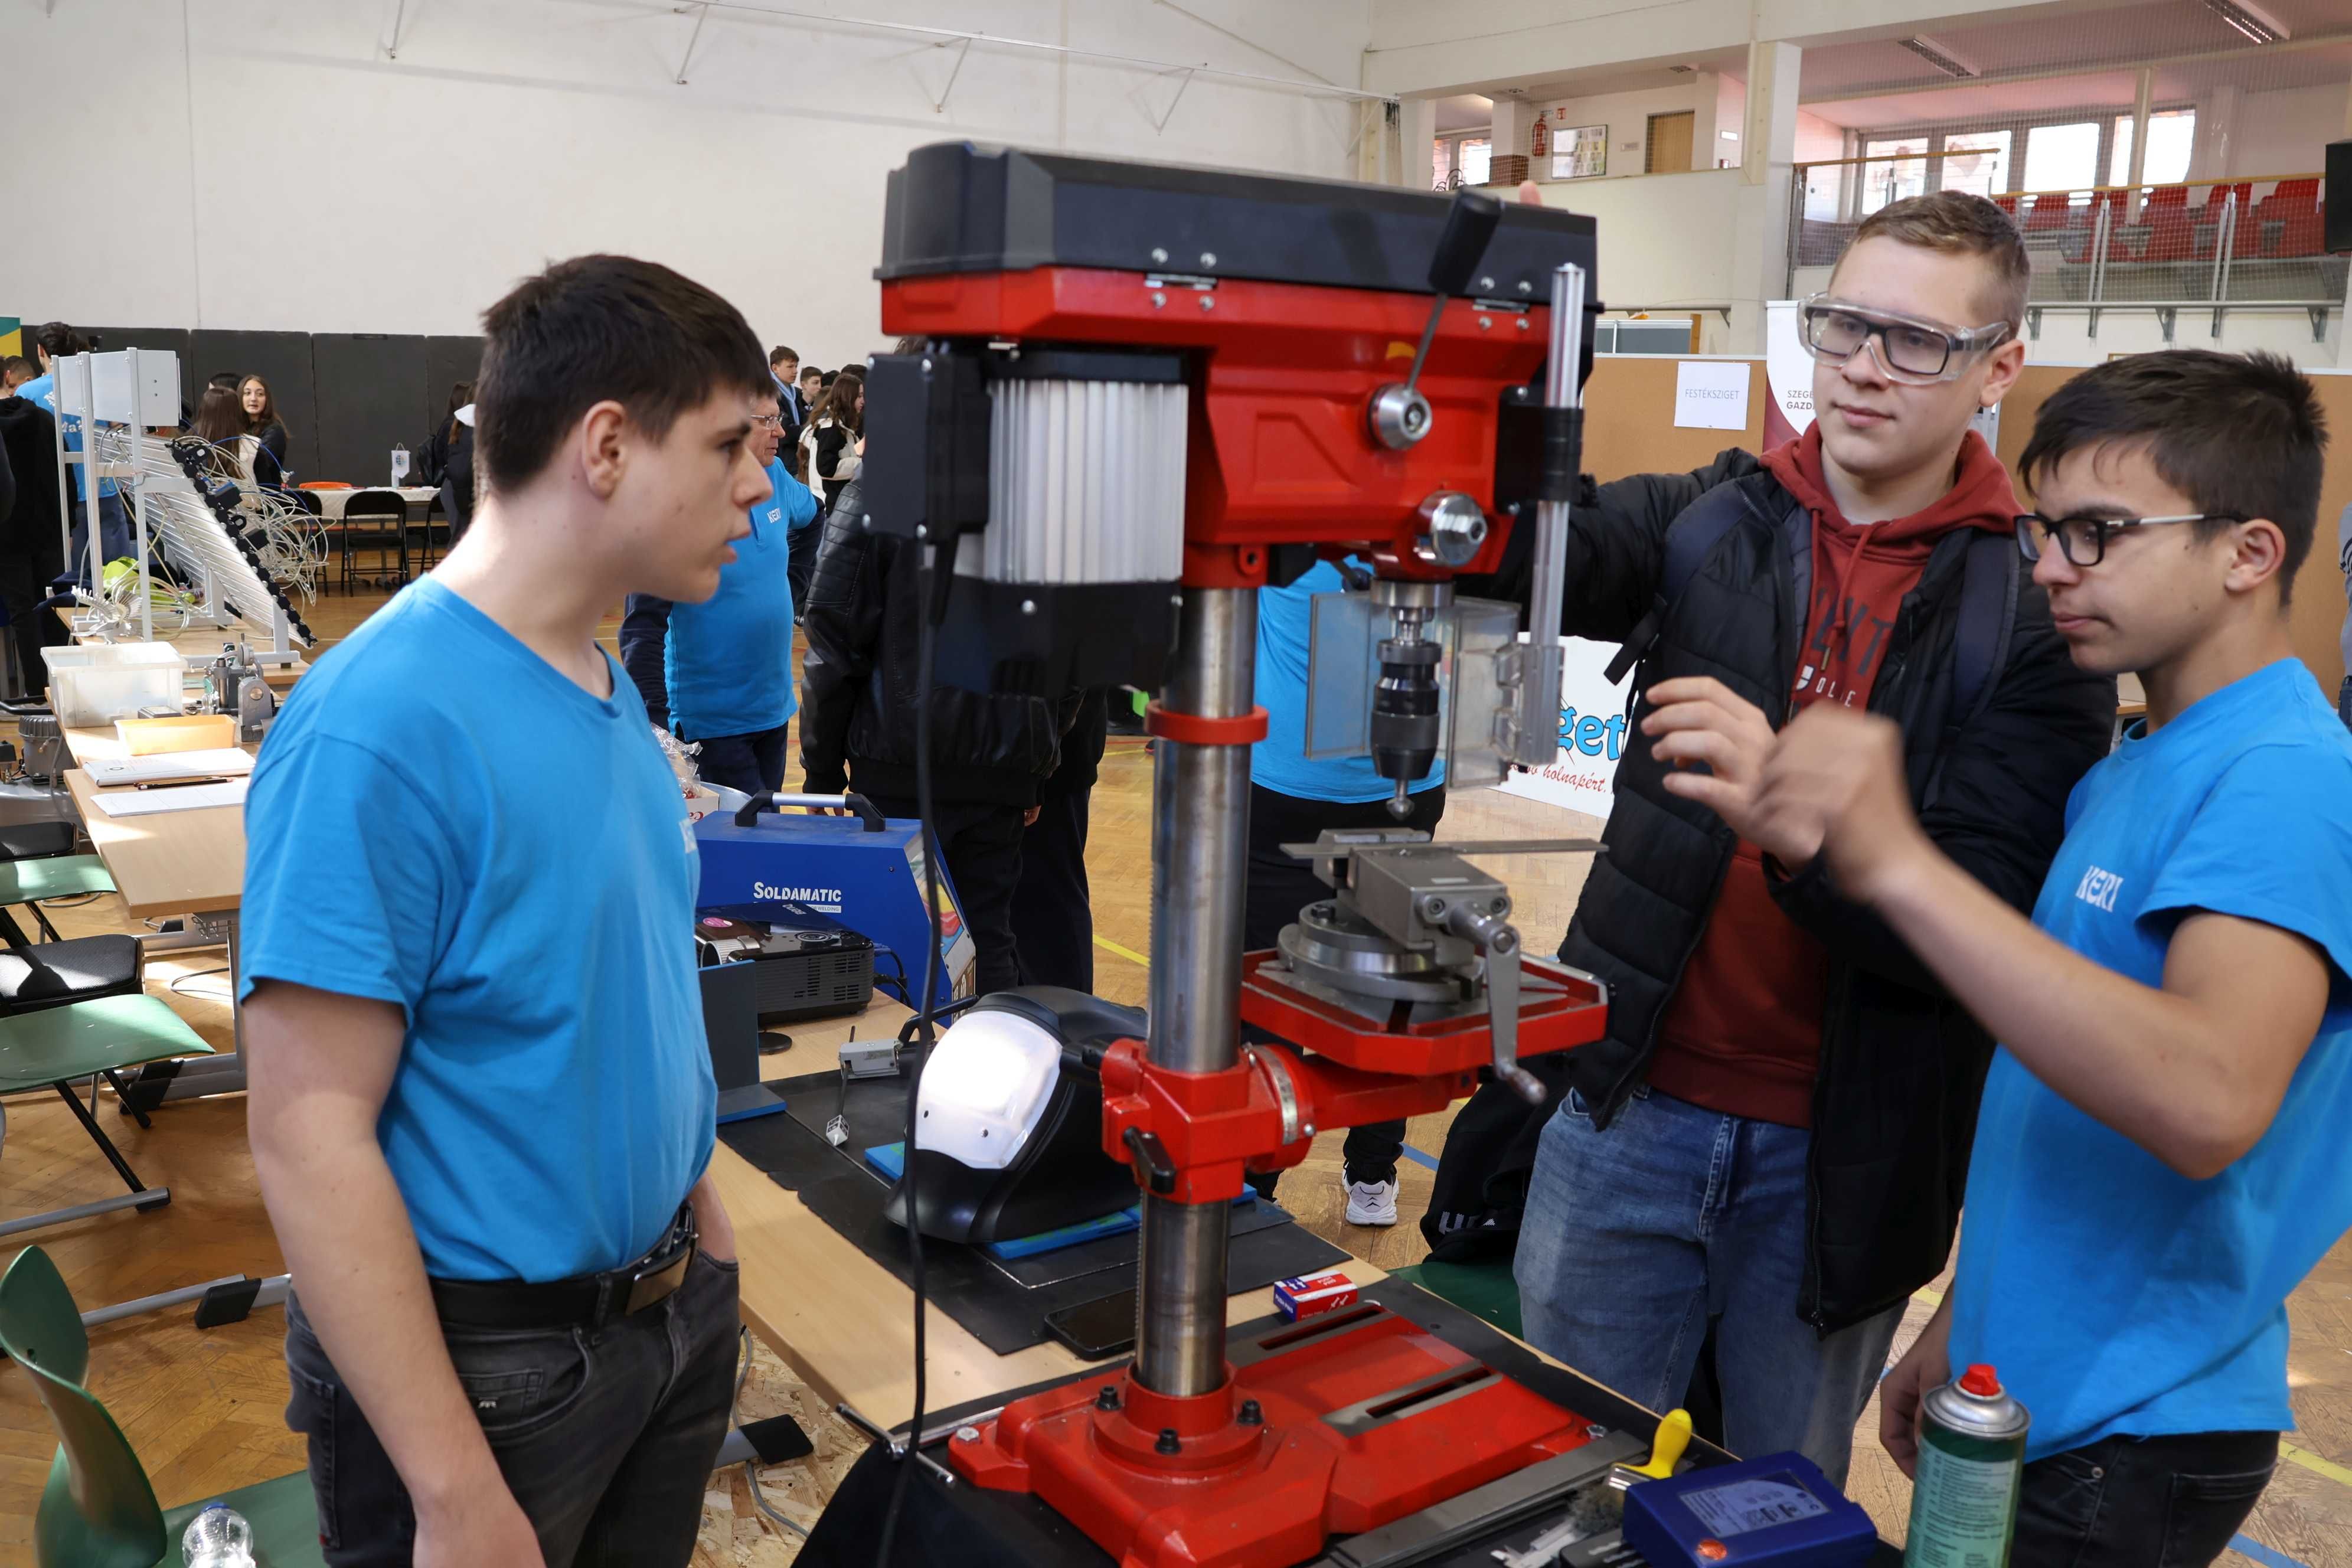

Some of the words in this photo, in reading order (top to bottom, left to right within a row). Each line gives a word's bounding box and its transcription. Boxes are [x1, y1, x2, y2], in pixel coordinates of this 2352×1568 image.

[1685, 387, 1740, 400] FESTÉKSZIGET
[1786, 401, 1814, 410] GAZD
[1543, 764, 1606, 793] holnapért.
[753, 881, 841, 902] SOLDAMATIC
